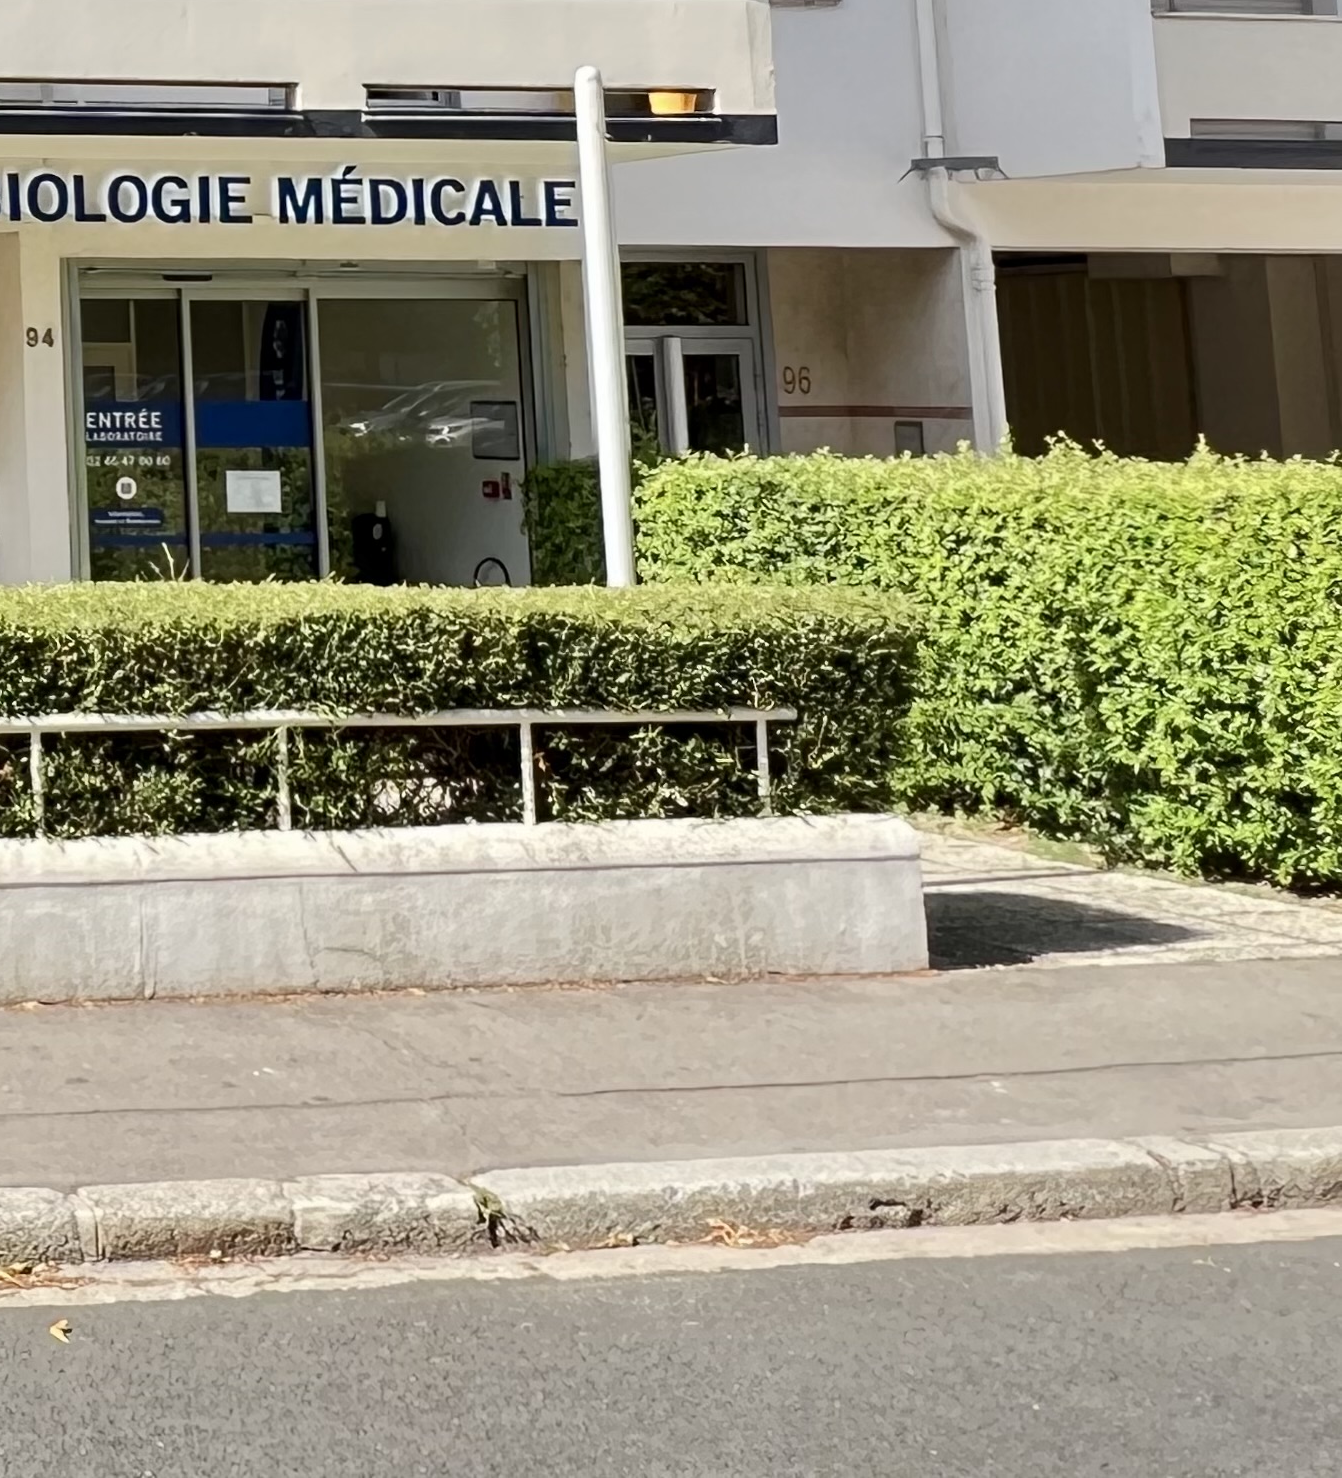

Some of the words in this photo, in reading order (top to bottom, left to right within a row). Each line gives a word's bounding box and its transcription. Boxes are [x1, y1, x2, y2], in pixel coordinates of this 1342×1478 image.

[279, 165, 579, 226] MÉDICALE
[26, 326, 54, 348] 94
[783, 366, 811, 394] 96
[86, 408, 163, 429] ENTRÉE
[85, 431, 163, 441] LABORATOIRE
